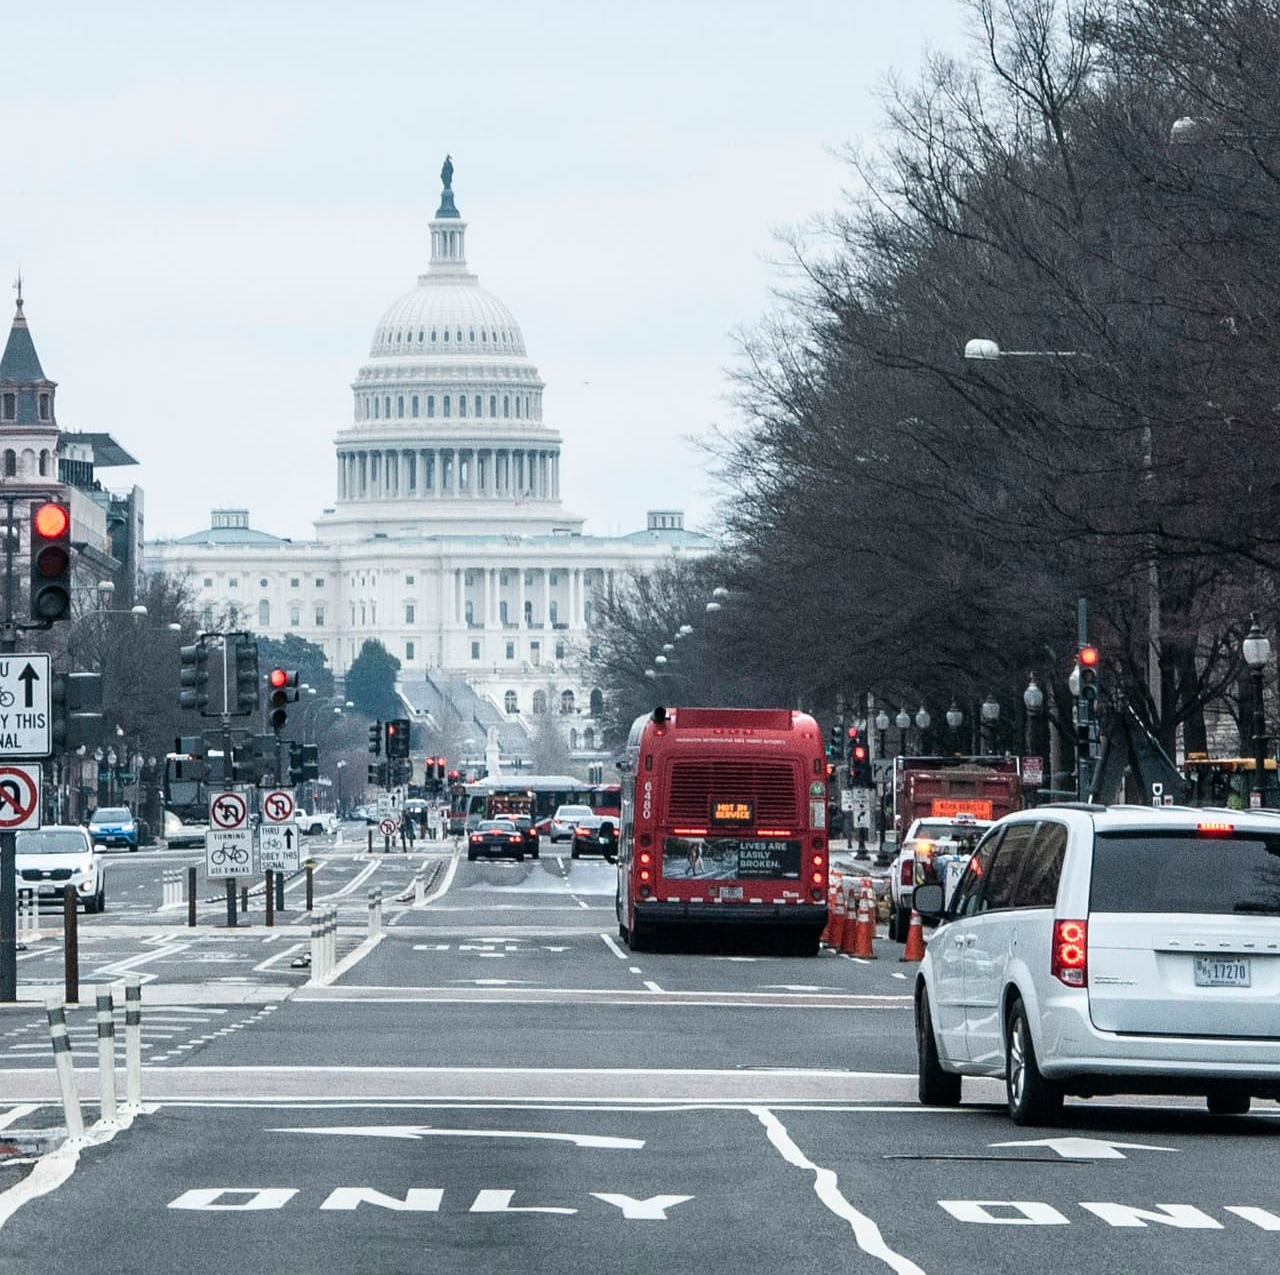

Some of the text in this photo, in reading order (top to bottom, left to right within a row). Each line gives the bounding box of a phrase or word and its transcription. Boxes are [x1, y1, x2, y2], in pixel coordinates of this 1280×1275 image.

[15, 713, 46, 729] THIS
[643, 781, 652, 819] 6480
[717, 803, 748, 812] NOT IN
[715, 811, 751, 819] SERVICE
[261, 827, 280, 835] THRU
[739, 842, 787, 851] LIVES ARE
[261, 852, 297, 860] OBEY THIS
[739, 851, 771, 859] EASILY
[262, 862, 285, 870] SIGNAL
[739, 860, 781, 869] BROKEN.
[413, 944, 572, 952] ONLY
[1214, 964, 1246, 979] 17270
[166, 1187, 696, 1219] ONLY
